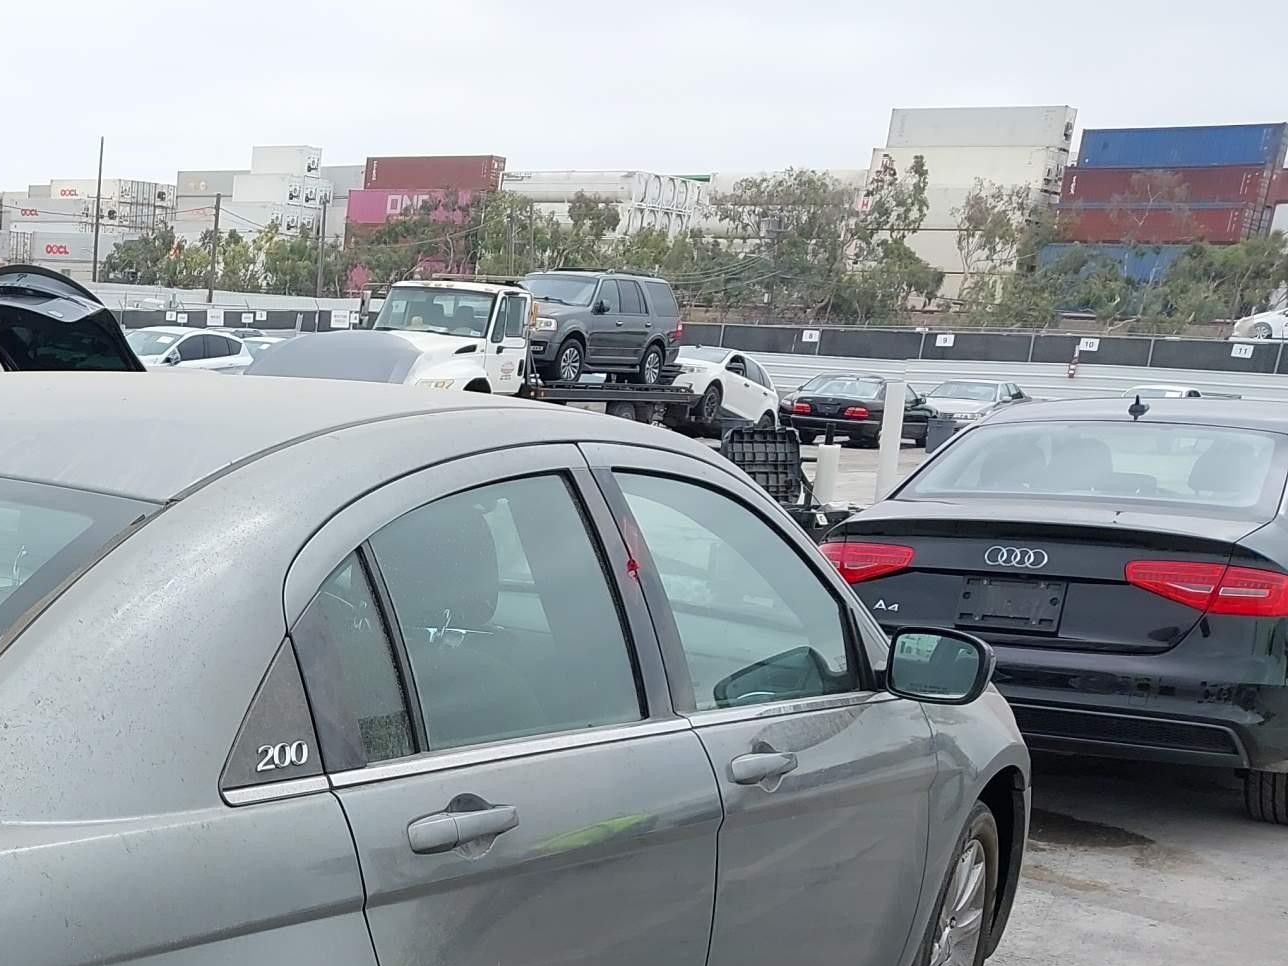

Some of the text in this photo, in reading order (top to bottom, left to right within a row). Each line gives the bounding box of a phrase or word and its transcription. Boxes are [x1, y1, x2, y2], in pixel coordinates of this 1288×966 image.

[61, 188, 78, 197] OOCL
[20, 208, 39, 217] OOCL
[45, 243, 70, 255] OOCL
[872, 599, 899, 611] A4
[256, 740, 309, 772] 200
